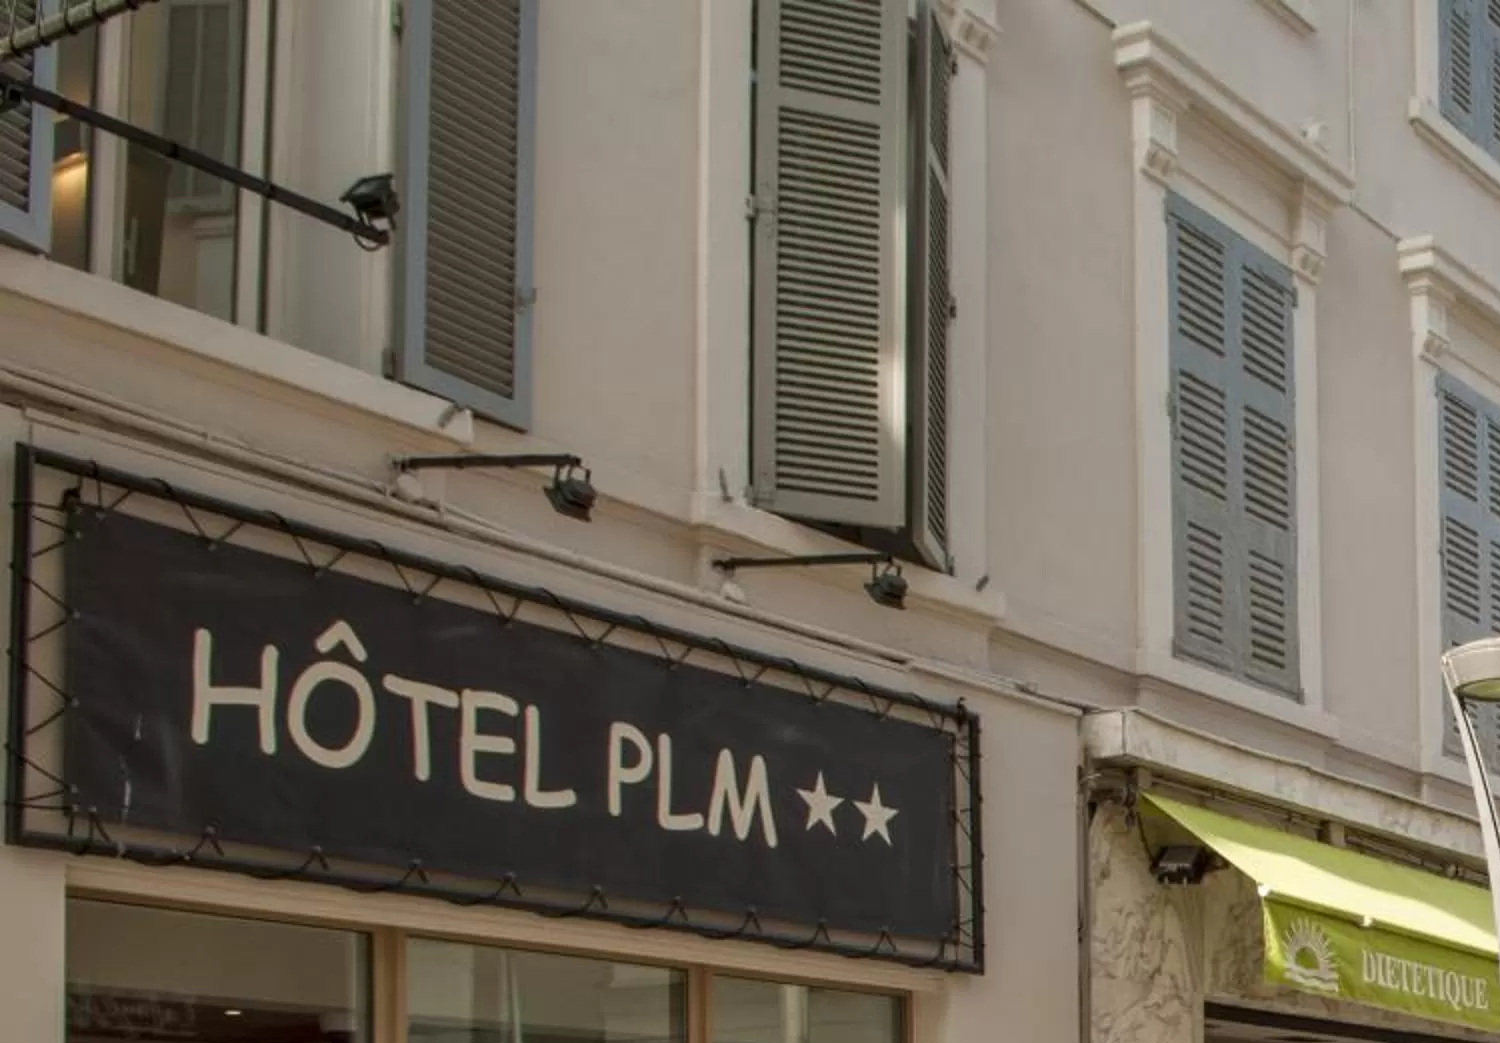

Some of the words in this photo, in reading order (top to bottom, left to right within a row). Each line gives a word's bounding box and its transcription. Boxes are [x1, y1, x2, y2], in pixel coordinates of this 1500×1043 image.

[191, 619, 577, 810] HÔTEL
[607, 720, 780, 848] PLM
[1361, 948, 1489, 1011] DIETETIQUE
